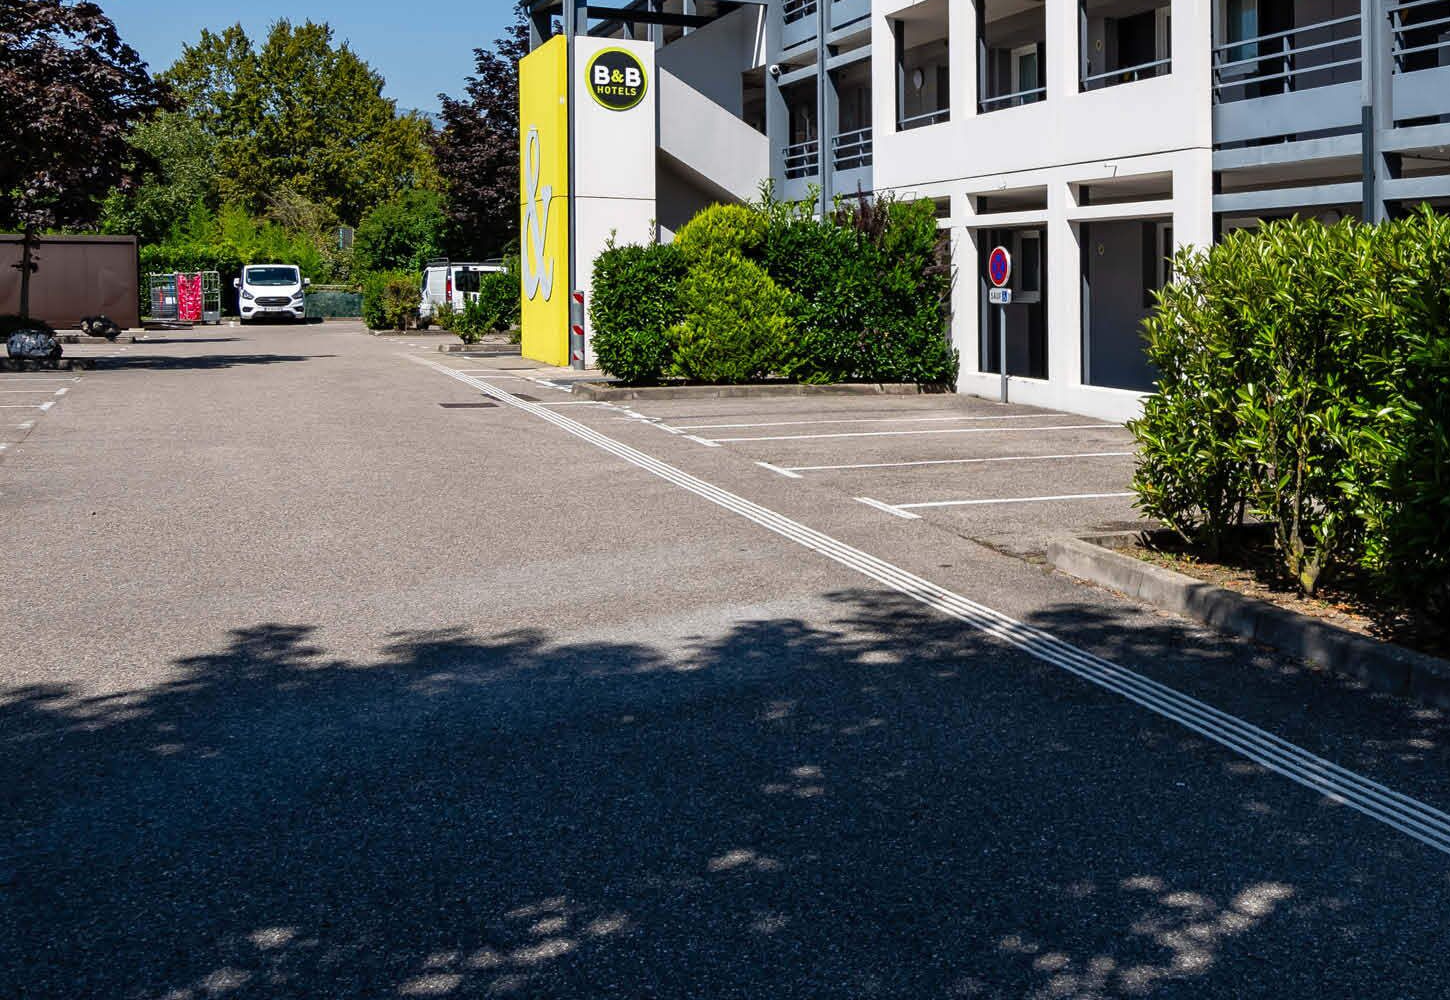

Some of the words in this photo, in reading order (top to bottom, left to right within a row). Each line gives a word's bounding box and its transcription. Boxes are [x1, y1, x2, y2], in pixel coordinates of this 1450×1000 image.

[594, 65, 641, 87] B&B
[597, 86, 637, 96] HOTELS
[522, 126, 555, 302] &
